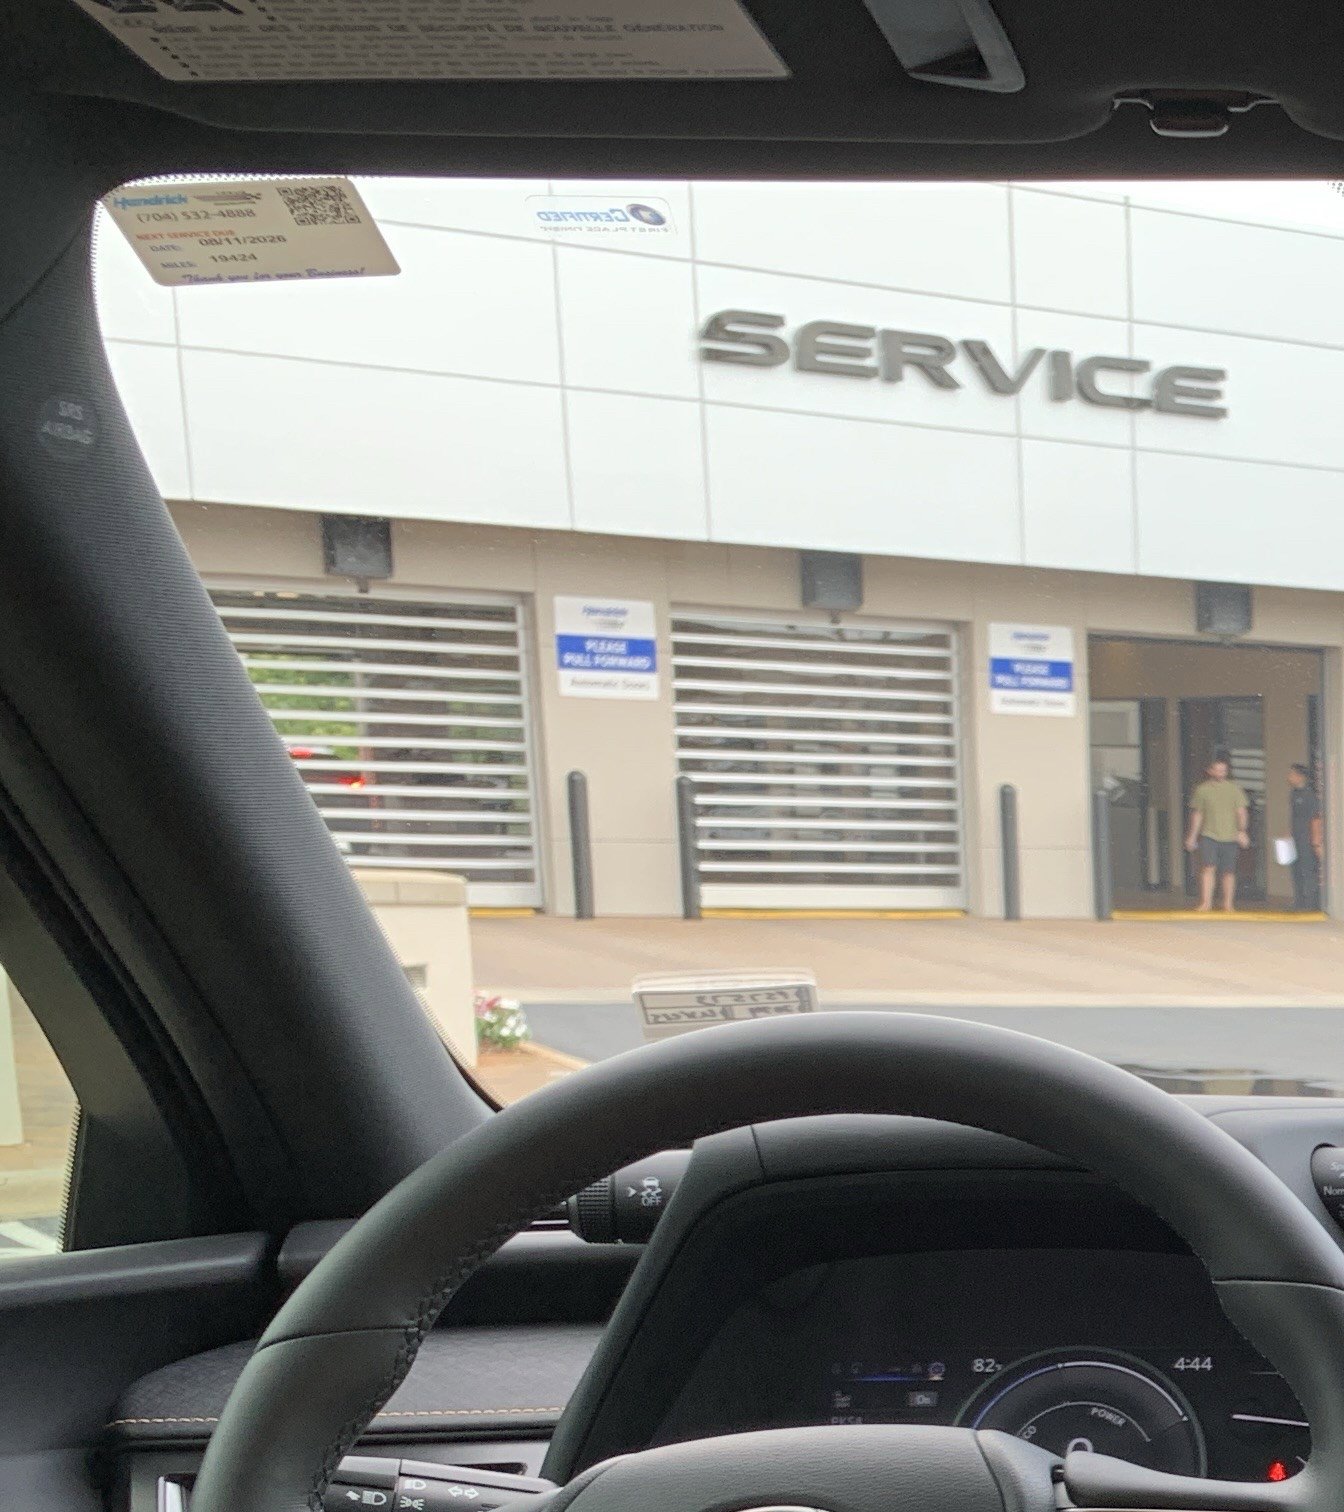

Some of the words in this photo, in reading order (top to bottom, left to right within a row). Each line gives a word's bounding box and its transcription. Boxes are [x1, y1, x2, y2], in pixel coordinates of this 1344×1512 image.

[699, 308, 1228, 422] SERVICE
[1173, 1356, 1214, 1372] 4:44
[1090, 1406, 1128, 1428] POWER
